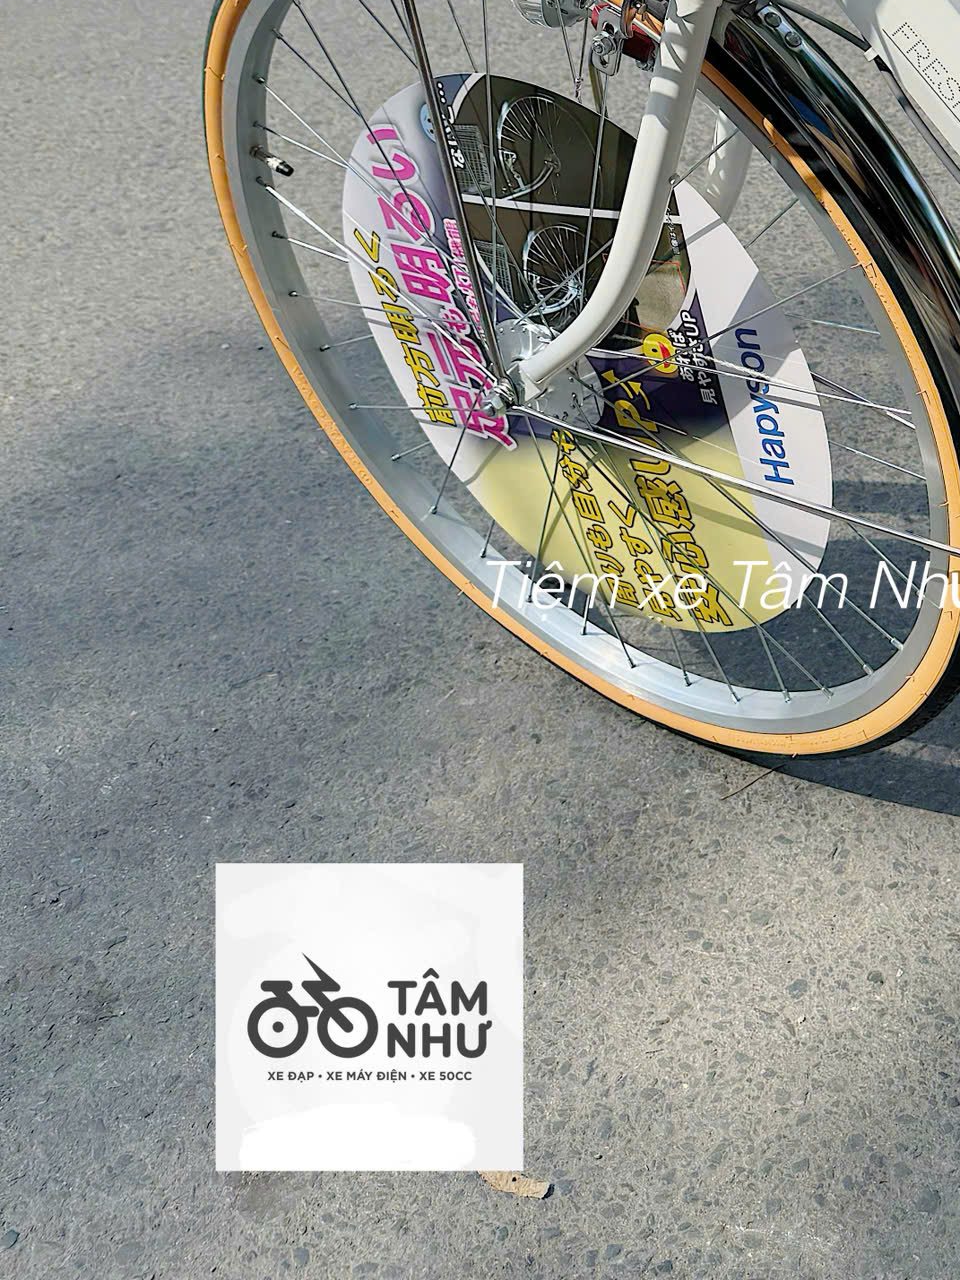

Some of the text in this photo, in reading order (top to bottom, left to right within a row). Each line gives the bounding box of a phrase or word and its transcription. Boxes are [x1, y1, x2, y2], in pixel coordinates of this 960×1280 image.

[353, 228, 458, 427] 前方明るく
[366, 127, 516, 449] 足元も明るい
[668, 330, 695, 382] あれば
[681, 310, 718, 405] 見やすさUP
[734, 327, 795, 486] Hapyson
[608, 500, 683, 622] 見やすく
